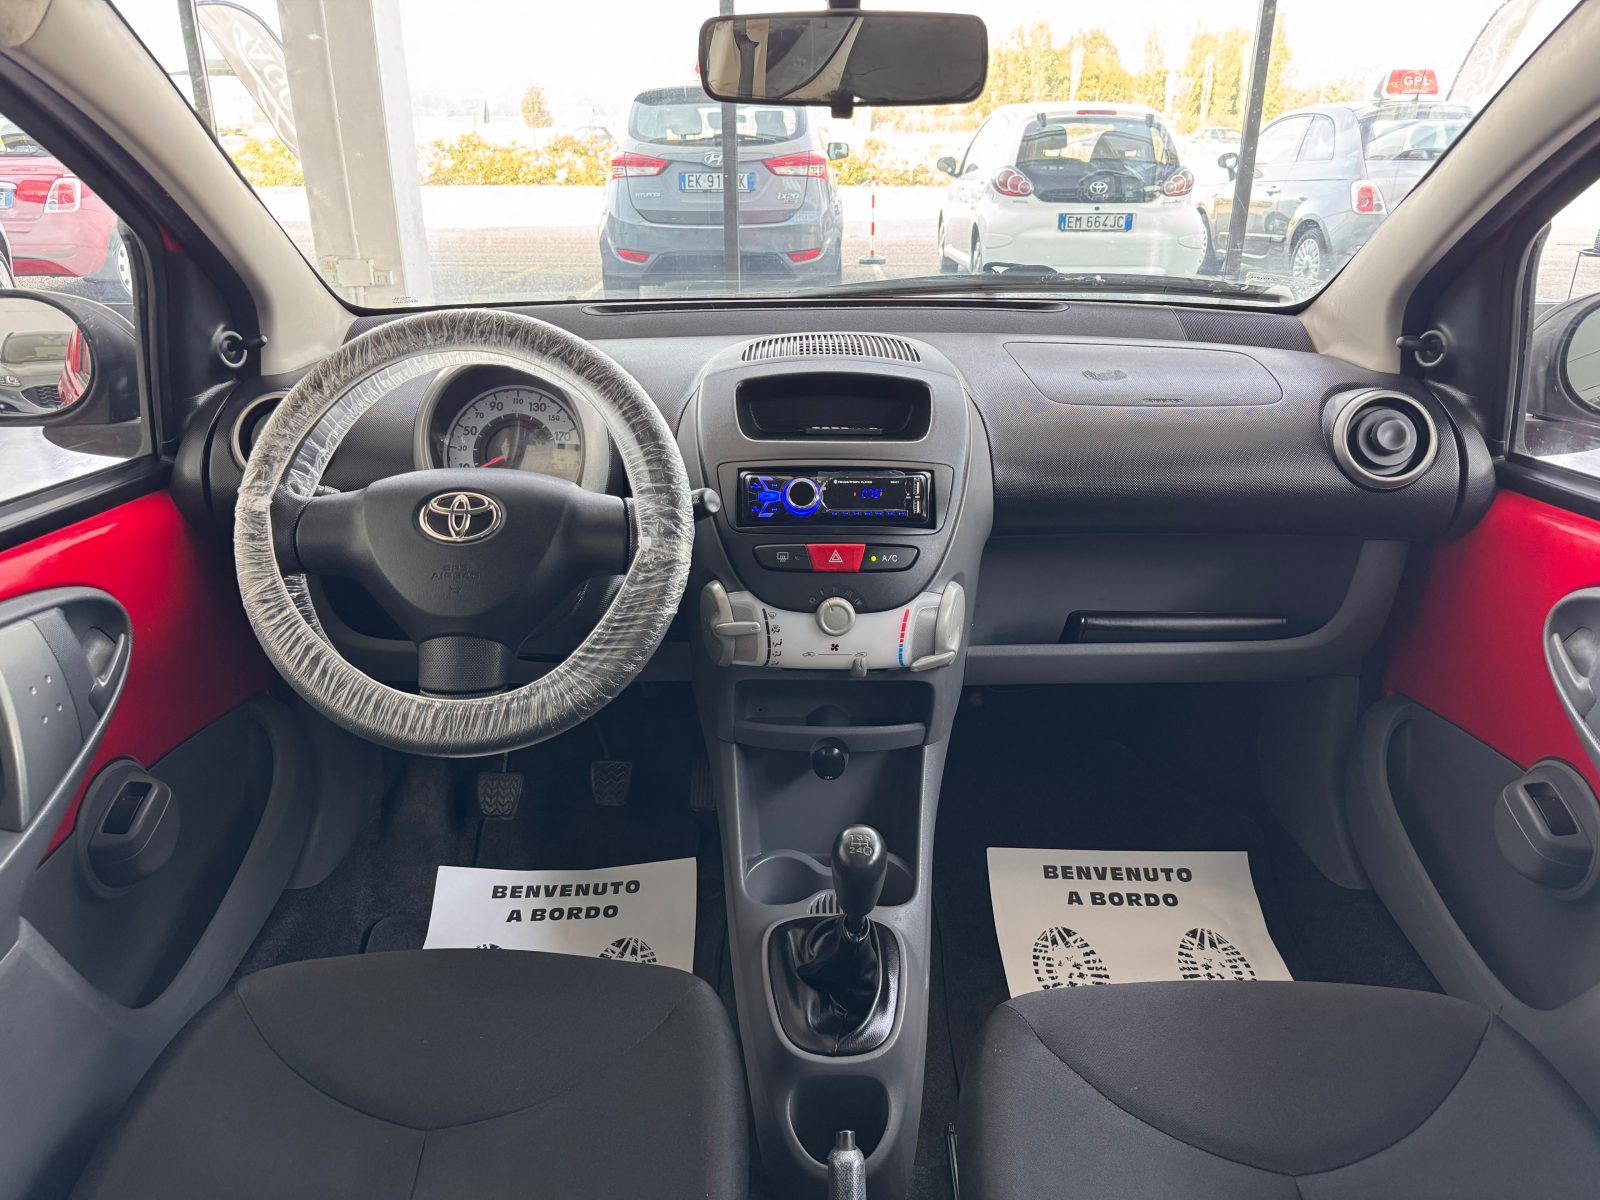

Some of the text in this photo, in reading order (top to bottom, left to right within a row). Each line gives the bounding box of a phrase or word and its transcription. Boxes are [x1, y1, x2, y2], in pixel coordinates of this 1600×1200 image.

[1403, 75, 1431, 87] GPL
[687, 174, 702, 188] EK
[1066, 215, 1125, 229] EM 664JC
[489, 401, 504, 412] 90
[513, 397, 524, 405] 110
[529, 402, 547, 413] 130
[548, 414, 560, 422] 150
[463, 425, 478, 436] 50
[554, 430, 571, 442] 170
[881, 554, 898, 563] A/C
[1042, 864, 1193, 883] BENVENUTO
[491, 879, 641, 899] BENVENUTO
[1066, 890, 1179, 907] A BORDO
[505, 904, 619, 923] A BORDO
